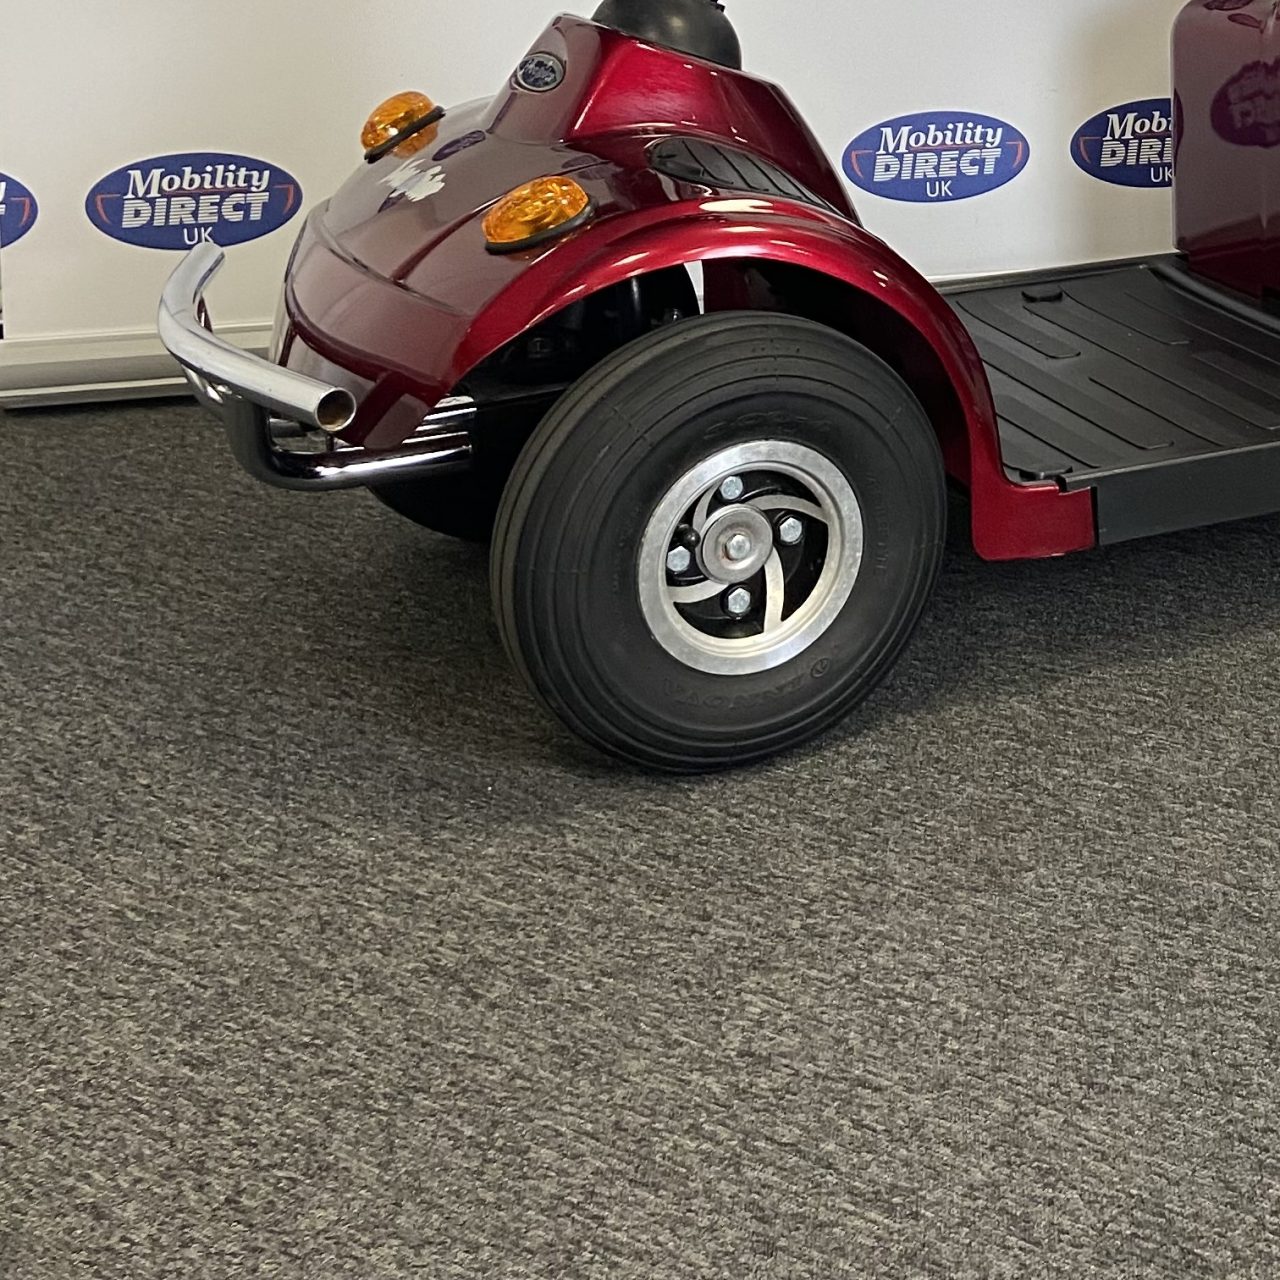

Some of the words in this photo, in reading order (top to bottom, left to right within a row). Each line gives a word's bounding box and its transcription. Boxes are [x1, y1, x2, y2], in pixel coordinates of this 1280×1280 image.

[876, 122, 1003, 154] Mobility
[873, 148, 1002, 182] DIRECT
[124, 164, 271, 200] Mobility
[926, 180, 954, 199] UK
[121, 192, 270, 229] DIRECT
[183, 225, 214, 246] UK
